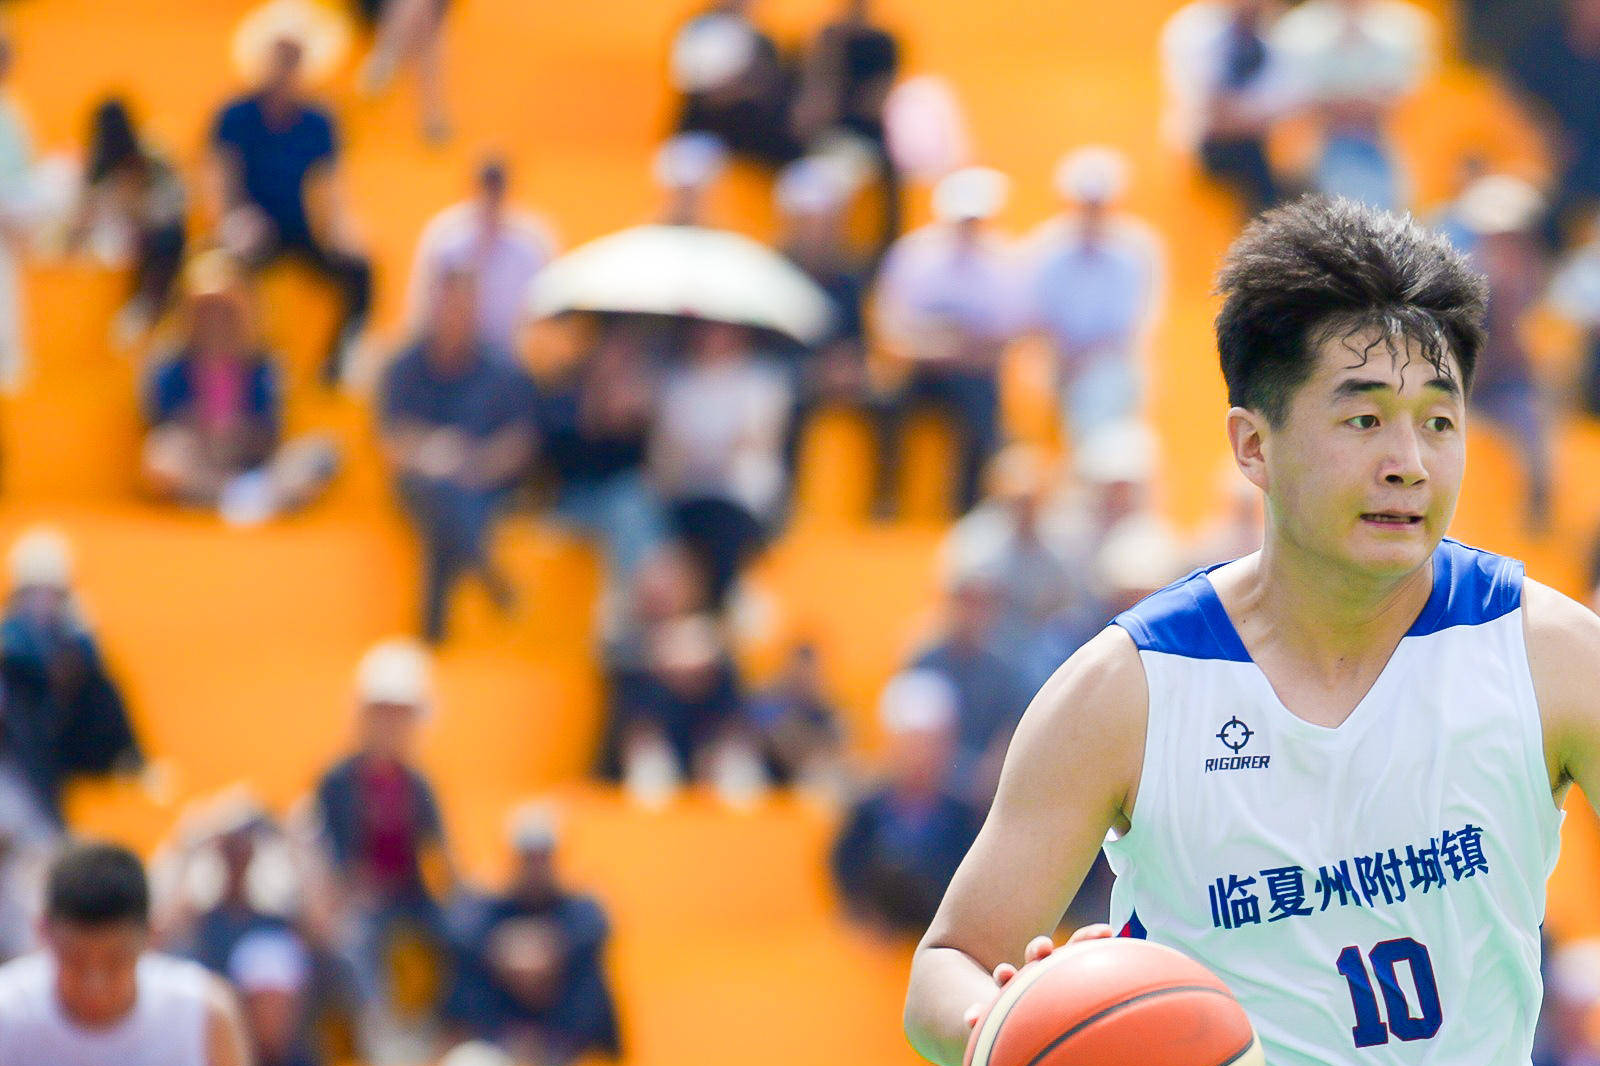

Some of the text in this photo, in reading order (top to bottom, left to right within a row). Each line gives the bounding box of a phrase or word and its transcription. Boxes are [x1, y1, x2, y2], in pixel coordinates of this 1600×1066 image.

[1204, 755, 1271, 774] RIGORER
[1208, 823, 1490, 930] 临夏州附城镇
[1336, 937, 1443, 1048] 10
